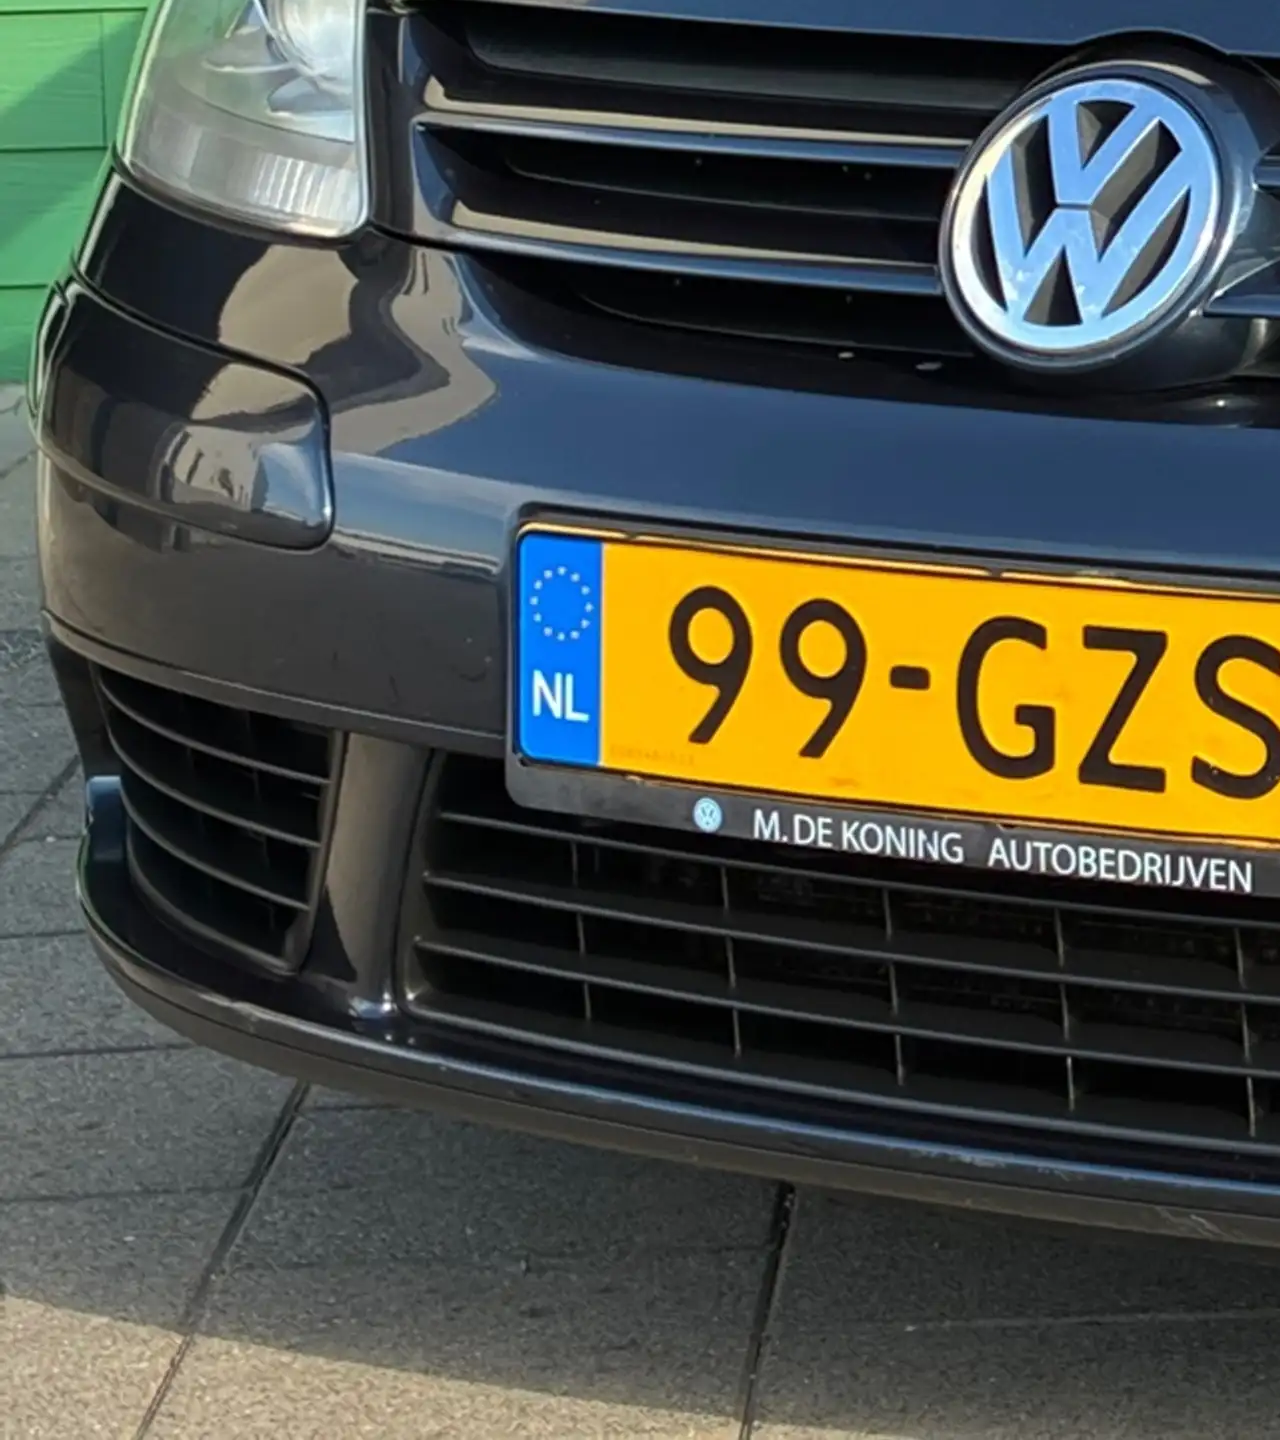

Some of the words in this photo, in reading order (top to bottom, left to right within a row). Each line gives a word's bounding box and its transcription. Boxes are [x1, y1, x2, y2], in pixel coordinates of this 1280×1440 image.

[532, 669, 590, 723] NL
[841, 820, 965, 864] KONING
[988, 837, 1252, 893] AUTOBEDRIJVEN
